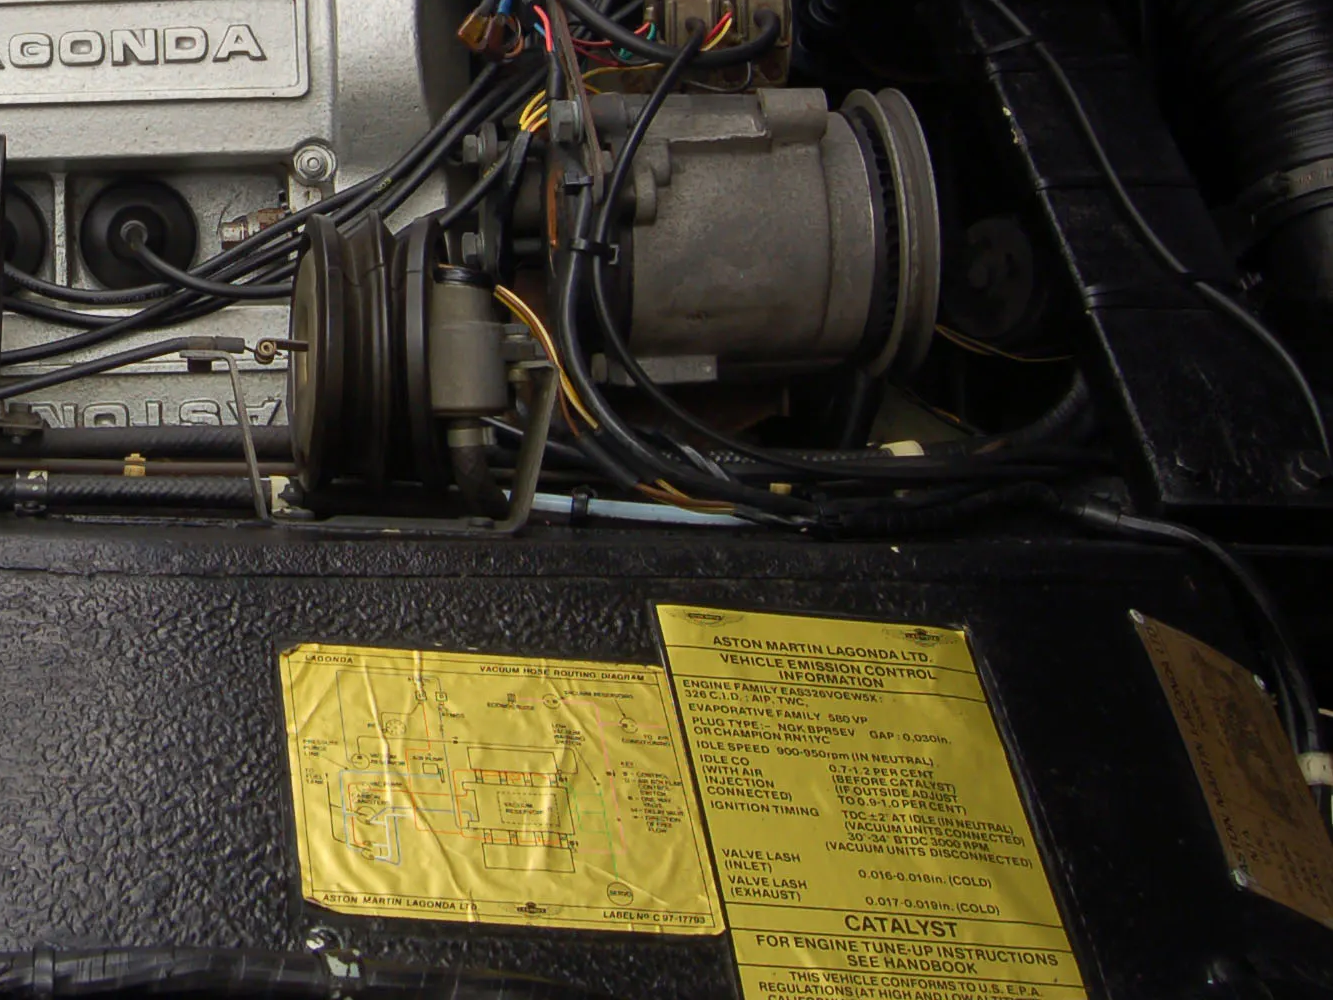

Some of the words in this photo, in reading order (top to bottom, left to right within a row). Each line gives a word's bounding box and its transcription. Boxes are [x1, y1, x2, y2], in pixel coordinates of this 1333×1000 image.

[713, 636, 762, 650] ASTON
[766, 640, 823, 655] MARTIN
[826, 645, 898, 660] LAGONDA
[901, 651, 934, 663] LTD.
[305, 654, 354, 665] LAGONDA
[719, 652, 783, 668] VEHICLE
[787, 659, 861, 675] EMISSION
[865, 665, 937, 680] CONTROL
[479, 665, 520, 674] VACUUM
[523, 667, 550, 676] HOSE
[554, 669, 596, 679] ROUTING
[601, 671, 644, 681] DIAGRAM
[779, 670, 884, 688] INFORMATION
[682, 679, 730, 690] ENGINE
[733, 682, 778, 694] FAMILY
[684, 689, 707, 699] 326
[688, 702, 774, 718] EVAPORATIVE
[776, 709, 820, 721] FAMILY
[692, 716, 724, 727] PLUG
[777, 722, 805, 733] NGK
[869, 730, 894, 740] GAP
[693, 726, 712, 736] OR
[713, 728, 782, 741] CHAMPION
[696, 740, 725, 751] IDLE
[728, 743, 770, 755] SPEED
[851, 752, 869, 762] (IN
[700, 754, 728, 764] IDLE
[731, 756, 750, 766] CO
[701, 764, 739, 776] (WITH
[742, 768, 763, 778] AIR
[872, 767, 898, 777] PER
[900, 769, 934, 779] CENT
[704, 775, 775, 788] INJECTION
[831, 774, 887, 786] (BEFORE
[889, 778, 956, 794] CATALYST)
[706, 786, 793, 802] CONNECTED)
[834, 785, 850, 794] (IF
[853, 786, 910, 798] OUTSIDE
[912, 790, 957, 803] ADJUST
[710, 800, 770, 813] IGNITION
[772, 804, 820, 817] TIMING
[837, 795, 855, 805] TO
[902, 799, 927, 810] PER
[929, 801, 967, 816] CENT)
[841, 810, 867, 820] TDC
[891, 813, 907, 823] AT
[909, 814, 936, 825] IDLE
[937, 817, 954, 827] (IN
[956, 820, 1014, 835] NEUTRAL)
[844, 821, 903, 834] (VACUUM
[904, 825, 943, 836] UNITS
[944, 828, 1026, 847] CONNECTED)
[893, 835, 928, 846] BTDC
[962, 840, 990, 852] RPM
[722, 848, 766, 860] VALVE
[767, 852, 801, 863] LASH
[825, 841, 884, 854] (VACUUM
[886, 845, 926, 857] UNITS
[930, 848, 1033, 869] DISCONNECTED)
[724, 860, 772, 874] (INLET)
[727, 875, 770, 887] VALVE
[772, 878, 808, 890] LASH
[949, 874, 992, 889] (COLD)
[323, 893, 357, 904] ASTON
[362, 896, 402, 906] MARTIN
[406, 899, 456, 910] LAGONDA
[730, 886, 801, 902] (EXHAUST)
[603, 910, 635, 920] LABEL
[956, 902, 1000, 916] (COLD)
[845, 914, 958, 938] CATALYST
[756, 934, 790, 948] FOR
[793, 937, 859, 953] ENGINE
[861, 941, 934, 957] TUNE-UP
[937, 945, 1059, 966] INSTRUCTIONS
[847, 954, 880, 968] SEE
[883, 956, 978, 974] HANDBOOK
[789, 971, 820, 983] THIS
[823, 973, 879, 987] VEHICLE
[881, 976, 956, 991] CONFORMS
[959, 982, 976, 992] TO
[759, 981, 856, 997] REGULATIONS
[855, 988, 875, 998] (AT
[878, 988, 912, 1000] HIGH
[915, 990, 942, 1000] AND
